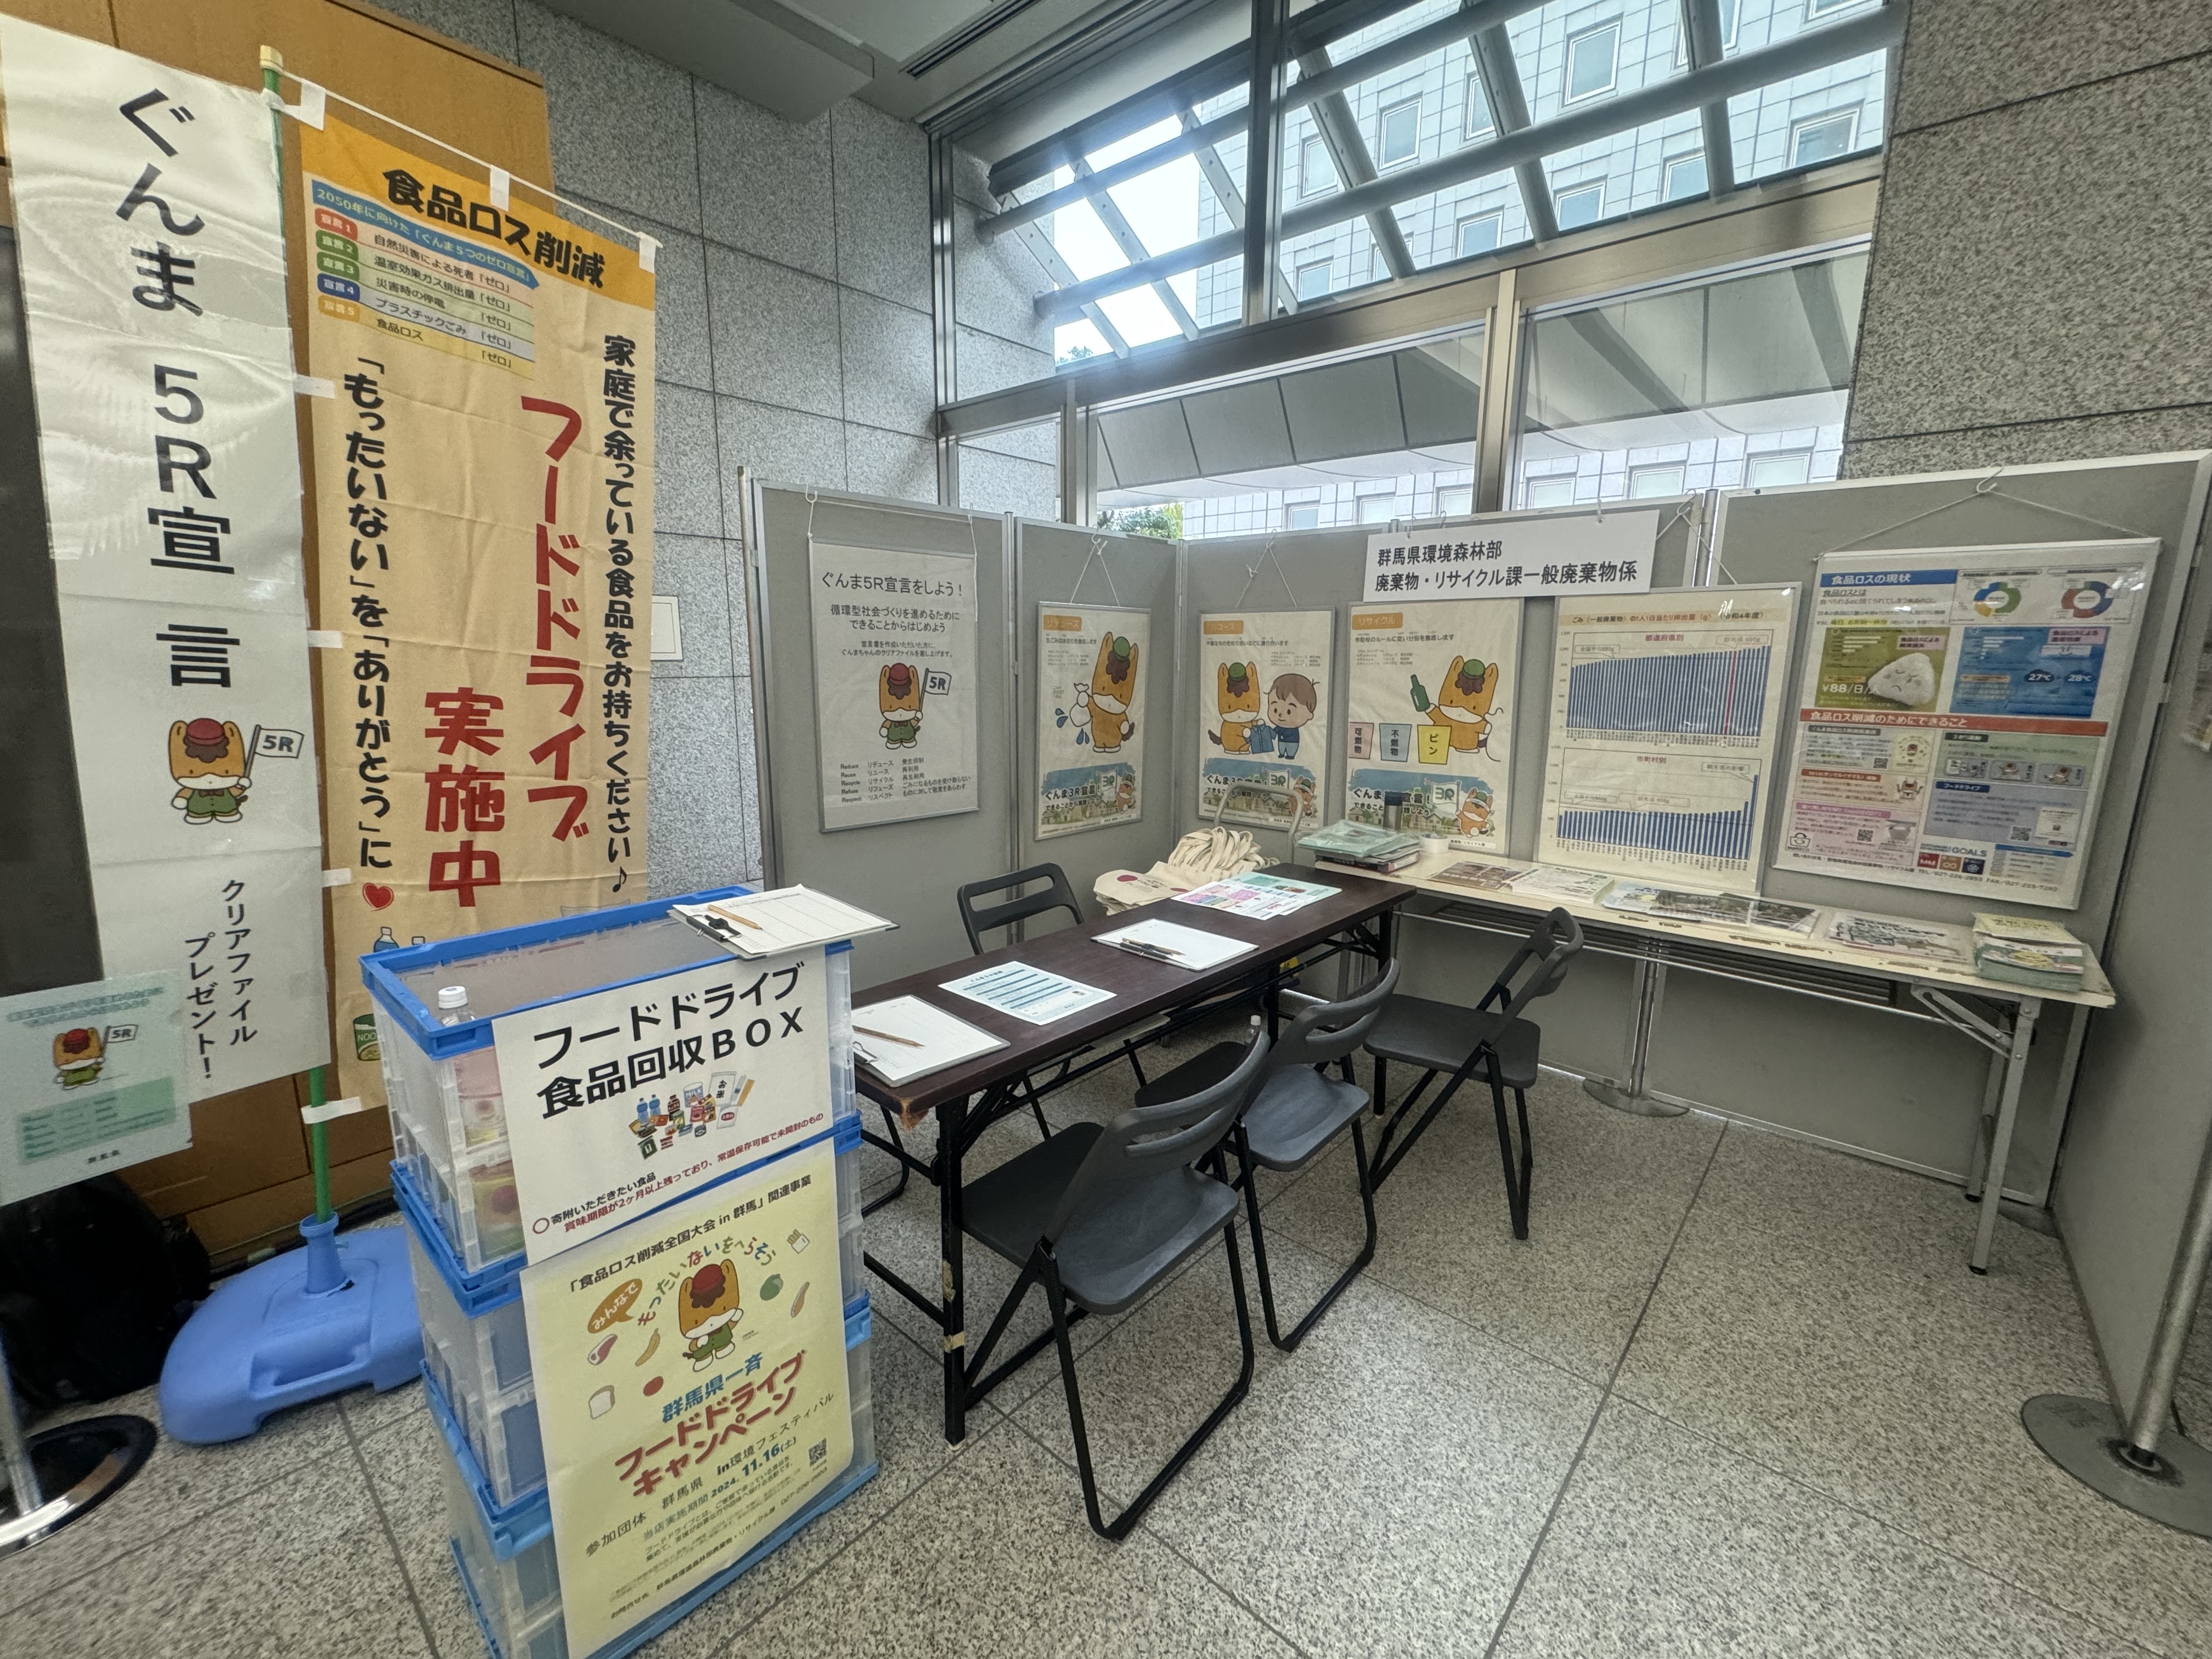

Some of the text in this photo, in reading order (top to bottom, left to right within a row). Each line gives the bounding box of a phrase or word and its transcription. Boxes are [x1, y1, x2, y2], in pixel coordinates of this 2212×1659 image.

[383, 169, 606, 289] 食品ロス削減
[375, 234, 474, 280] 自然災害による死者
[375, 256, 476, 300] 温室効果ガス排出量
[376, 278, 445, 309] 災害時の停電
[376, 297, 466, 335] プラスチックごみ
[377, 319, 424, 341] 食品ロス
[1378, 540, 1503, 567] 群馬県環境森林部
[822, 571, 962, 597] ぐんま5R宣言をしよう!
[1375, 560, 1638, 592] 廃棄物・リサイクル課一般廃棄物係
[1831, 573, 1911, 585] 食品ロスの現状
[1822, 589, 1867, 597] 食品ロスとは
[344, 357, 393, 868] 「もったいない」を「ありがとう」に
[521, 396, 589, 842] フードドライブ
[830, 604, 960, 621] 循環型社会づくりを進めるために
[849, 619, 946, 633] できることからはじめよう
[1359, 617, 1396, 625] リサイクル
[1645, 634, 1684, 642] 都道府県別
[929, 676, 946, 691] 5R
[1810, 711, 1968, 728] 食品ロス削減のためにできること
[262, 732, 294, 754] 5R
[1390, 729, 1400, 757] 不燃物
[1429, 732, 1438, 756] ビン
[1636, 755, 1667, 764] 市町村別
[868, 776, 894, 785] リサイクル
[424, 687, 506, 907] 実施中
[1951, 847, 1988, 857] GOALS
[221, 879, 258, 1046] クリアファイル
[185, 931, 218, 1079] プレゼント!
[534, 961, 805, 1069] フードドライブ
[537, 1007, 804, 1120] 食品回収BOX
[685, 1087, 703, 1097] MILK
[715, 1080, 727, 1099] お米
[551, 1172, 656, 1225] 寄附いただきたい食品
[719, 1212, 731, 1225] in
[768, 1174, 812, 1203] 関連事業
[592, 1282, 639, 1330] みんなで
[662, 1351, 763, 1424] 群馬県一斉
[614, 1349, 807, 1482] フードドライブ
[632, 1386, 797, 1498] キャンペーン
[585, 1393, 834, 1558] 参加団体 群馬県 in環境フェスティバル
